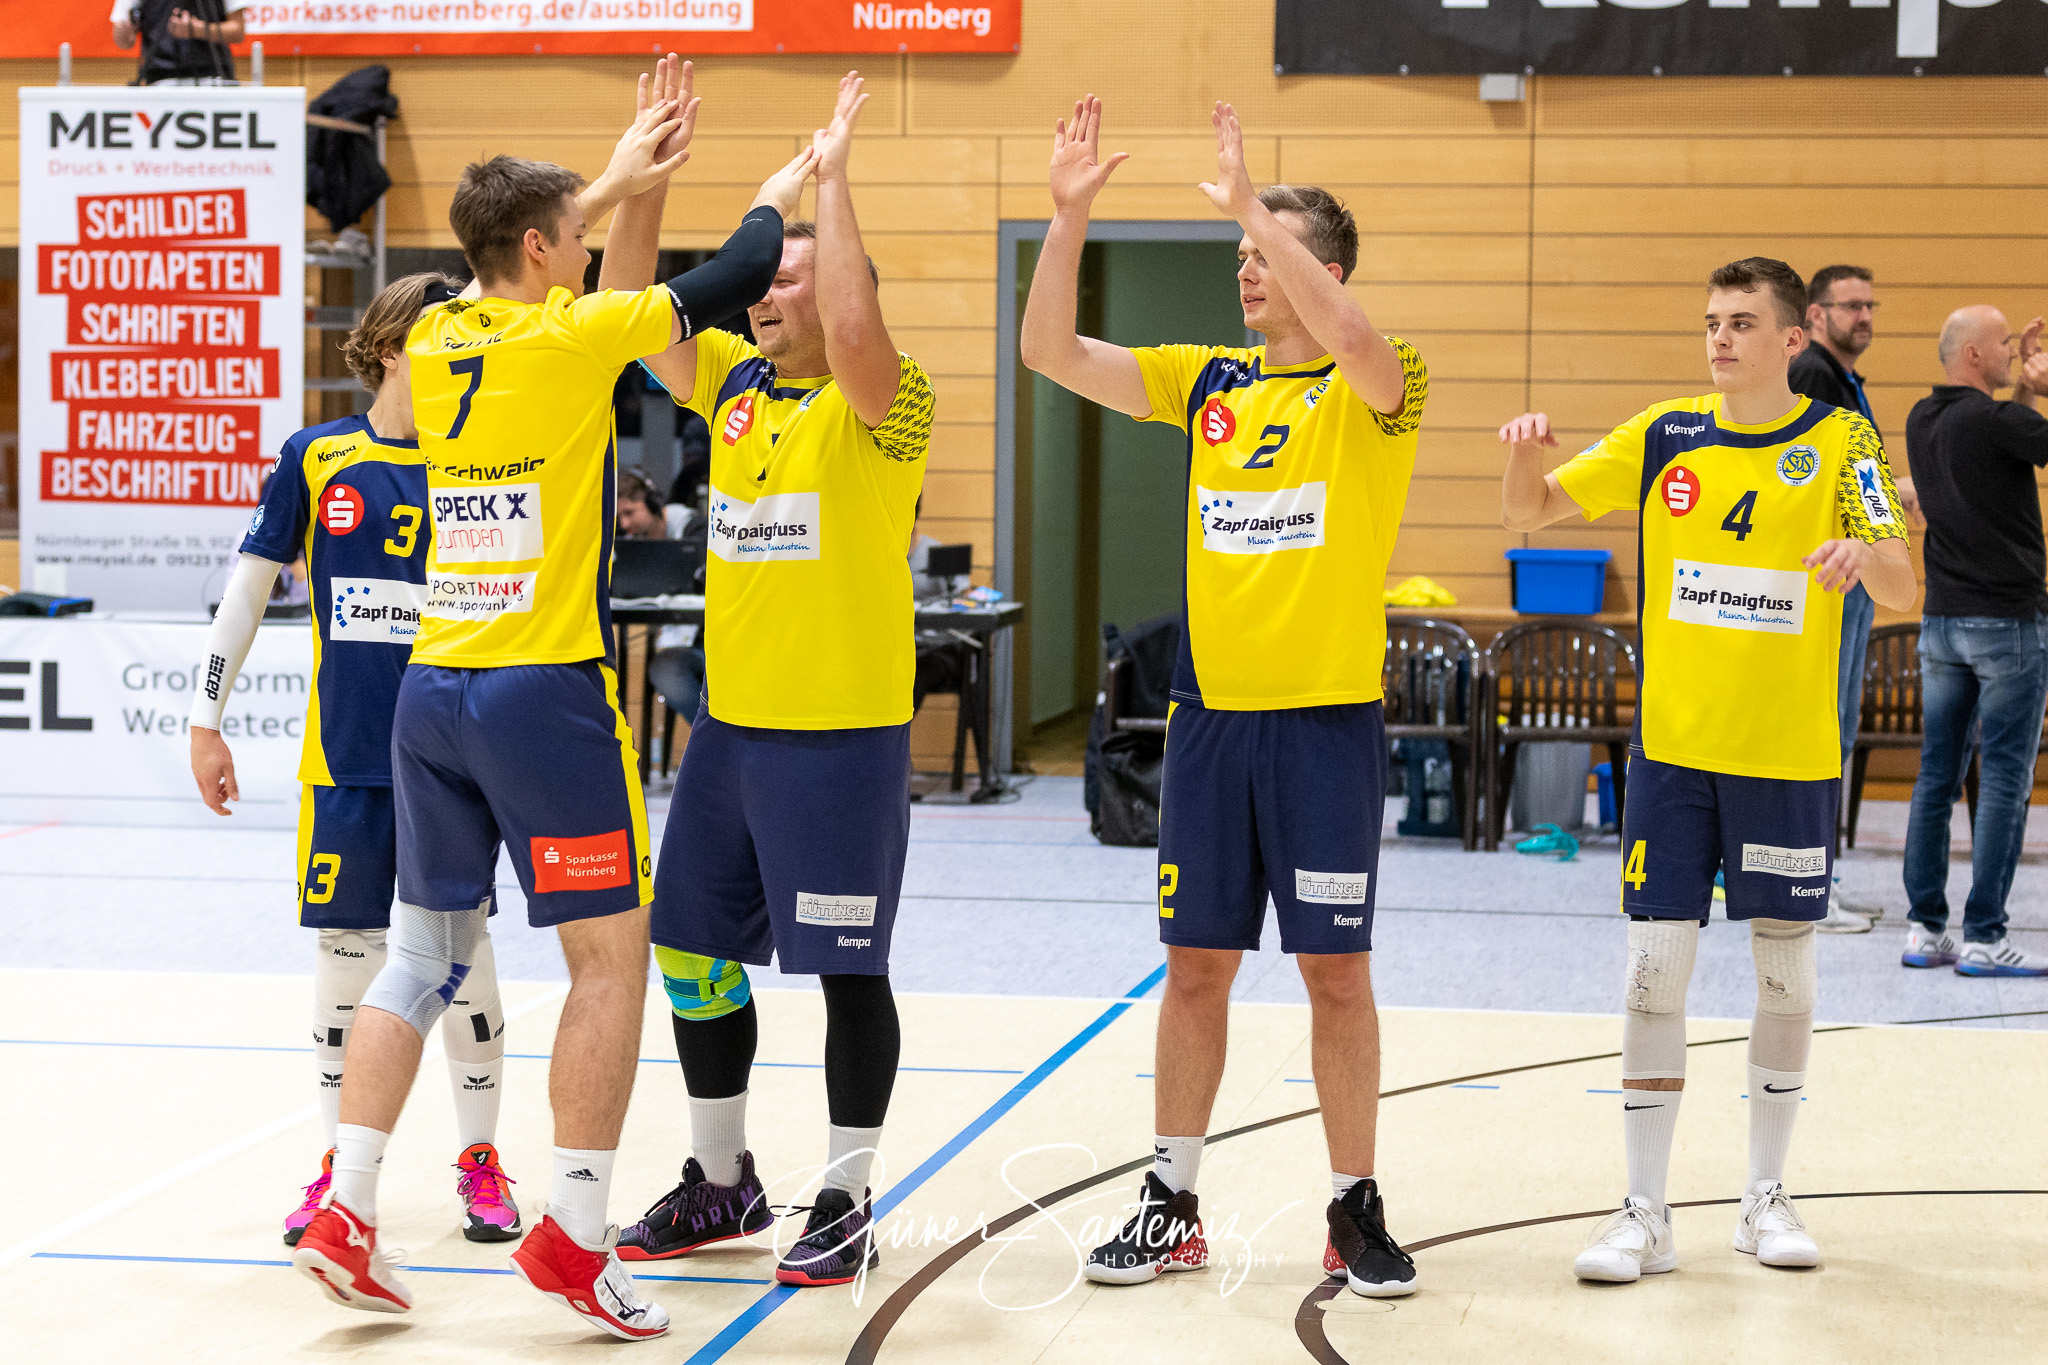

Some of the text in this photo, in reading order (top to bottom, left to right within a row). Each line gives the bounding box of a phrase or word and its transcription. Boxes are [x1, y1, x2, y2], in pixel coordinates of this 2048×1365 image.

[853, 2, 991, 36] Nürnberg
[50, 111, 277, 148] MEYSEL
[49, 159, 107, 176] Druck
[133, 159, 273, 176] Werbetechnik
[86, 194, 236, 240] SCHILDER
[52, 250, 264, 292] FOTOTAPETEN
[80, 303, 245, 346] SCHRIFTEN
[62, 357, 264, 399] KLEBEFOLIEN
[445, 354, 484, 440] 7
[78, 410, 254, 454] FAHRZEUG-
[1664, 424, 1705, 437] Kempa
[317, 445, 357, 463] Kempa
[1242, 424, 1290, 469] 2
[435, 494, 499, 522] SPECK
[1720, 490, 1759, 541] 4
[384, 504, 423, 558] 3
[716, 518, 808, 541] Zapf Daigfuss
[1212, 517, 1249, 534] Zapf
[350, 604, 388, 622] Zapf
[1680, 586, 1793, 611] Zapf Daigfuss
[566, 851, 618, 865] Sparkasse
[566, 865, 616, 878] Nürnberg
[1625, 840, 1647, 890] 4
[1746, 849, 1823, 869] HÜTTINGER
[306, 853, 341, 904] 3
[1160, 863, 1179, 919] 2
[1791, 886, 1826, 898] Kempa
[799, 898, 872, 917] HÜTTINGER
[837, 936, 871, 950] Kempa
[566, 1173, 599, 1181] adidas
[692, 1186, 760, 1232] HRLM
